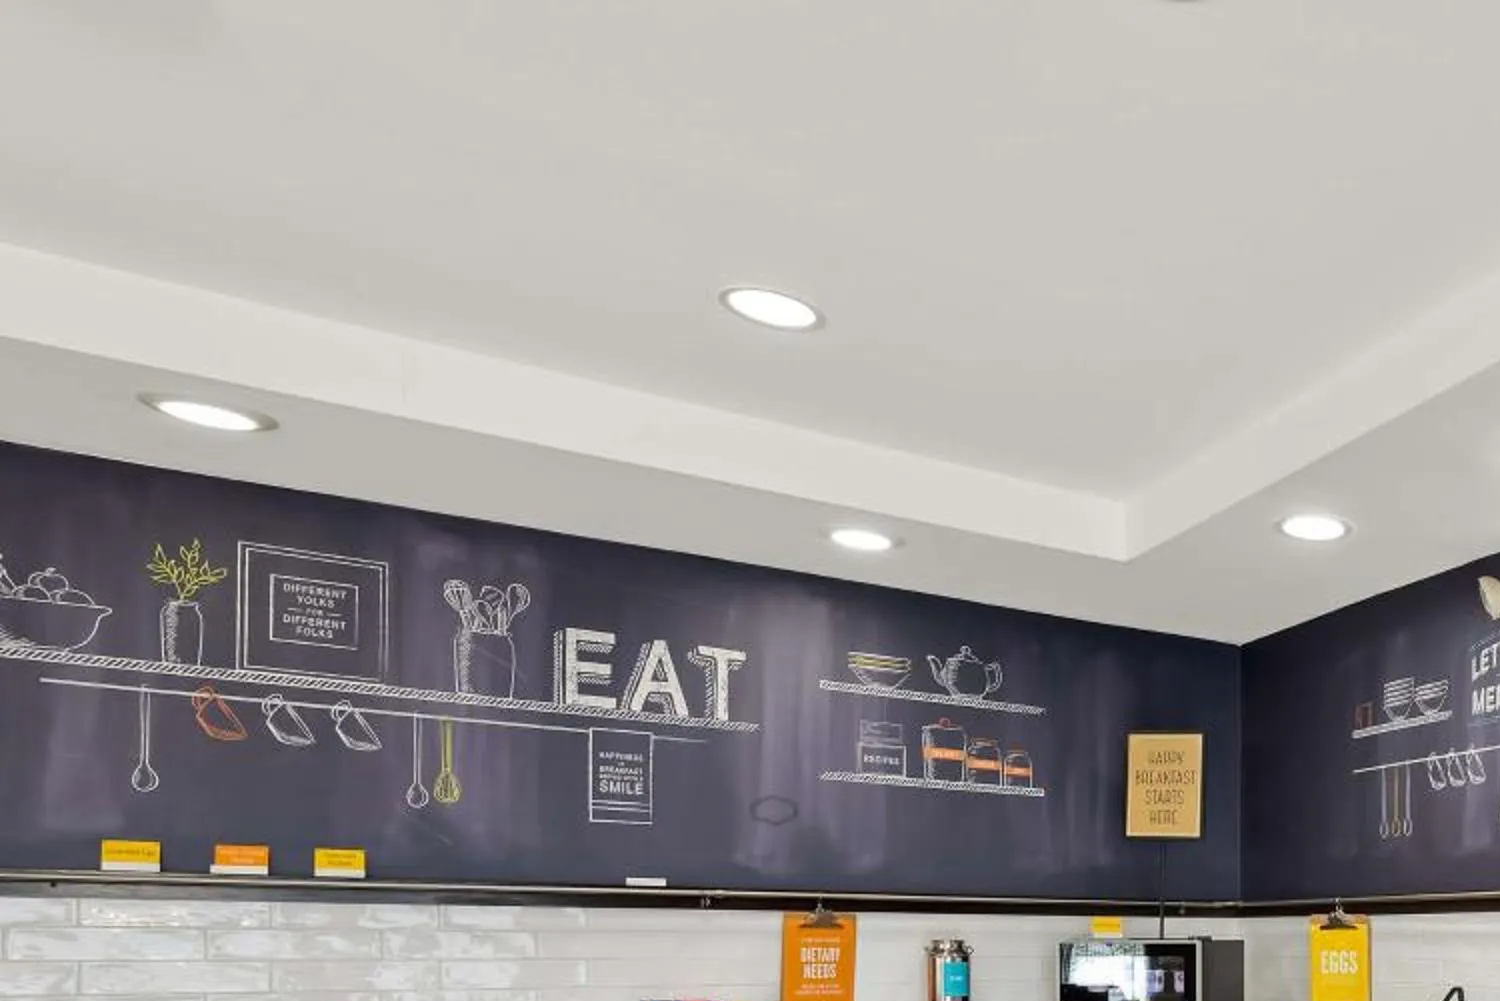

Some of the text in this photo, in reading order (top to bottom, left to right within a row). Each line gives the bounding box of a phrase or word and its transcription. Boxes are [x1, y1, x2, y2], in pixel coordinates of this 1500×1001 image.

[283, 583, 347, 599] DIFFERENT
[297, 596, 335, 609] YOLKS
[282, 613, 347, 631] DIFFERENT
[296, 626, 334, 639] FOLKS
[553, 627, 747, 721] EAT
[599, 779, 644, 795] SMILE
[1320, 950, 1358, 974] EGGS
